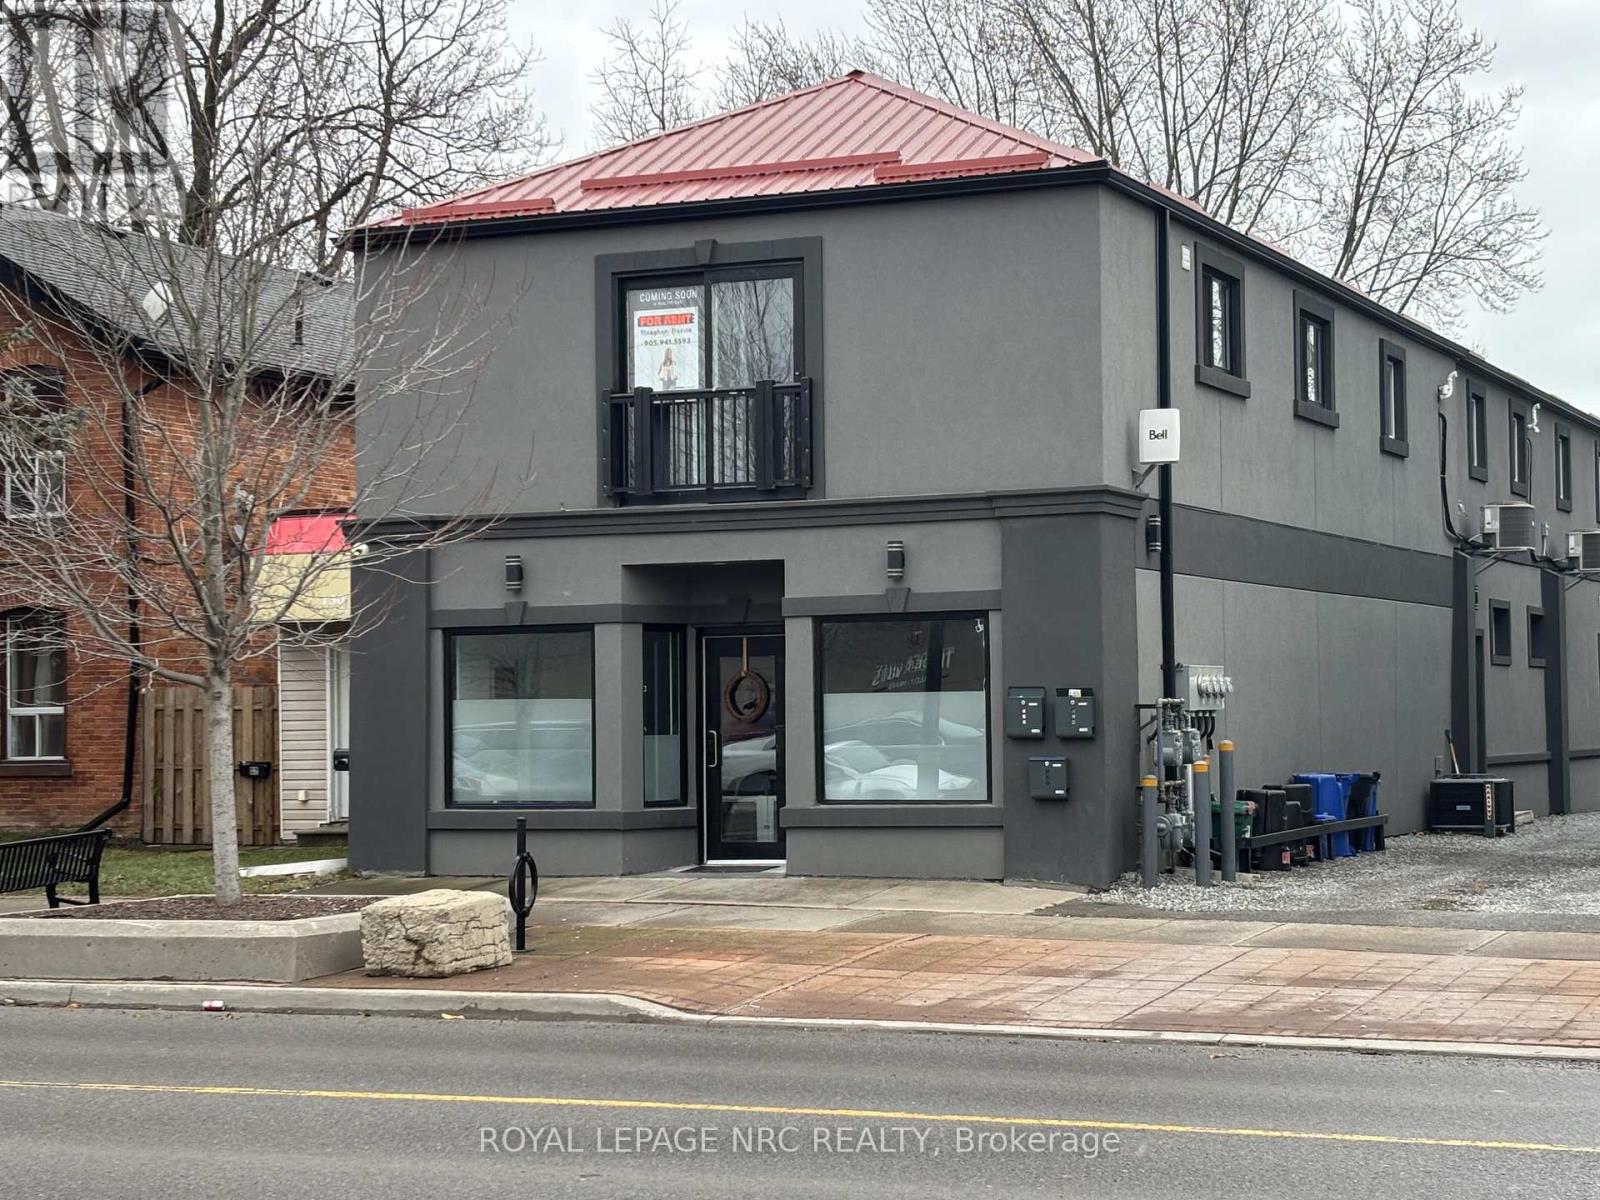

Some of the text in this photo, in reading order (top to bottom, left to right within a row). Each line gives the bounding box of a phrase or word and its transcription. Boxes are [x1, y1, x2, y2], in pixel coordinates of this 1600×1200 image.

[639, 289, 698, 302] COMING SOON
[640, 314, 690, 326] FOR RENT
[1149, 430, 1168, 440] Bell
